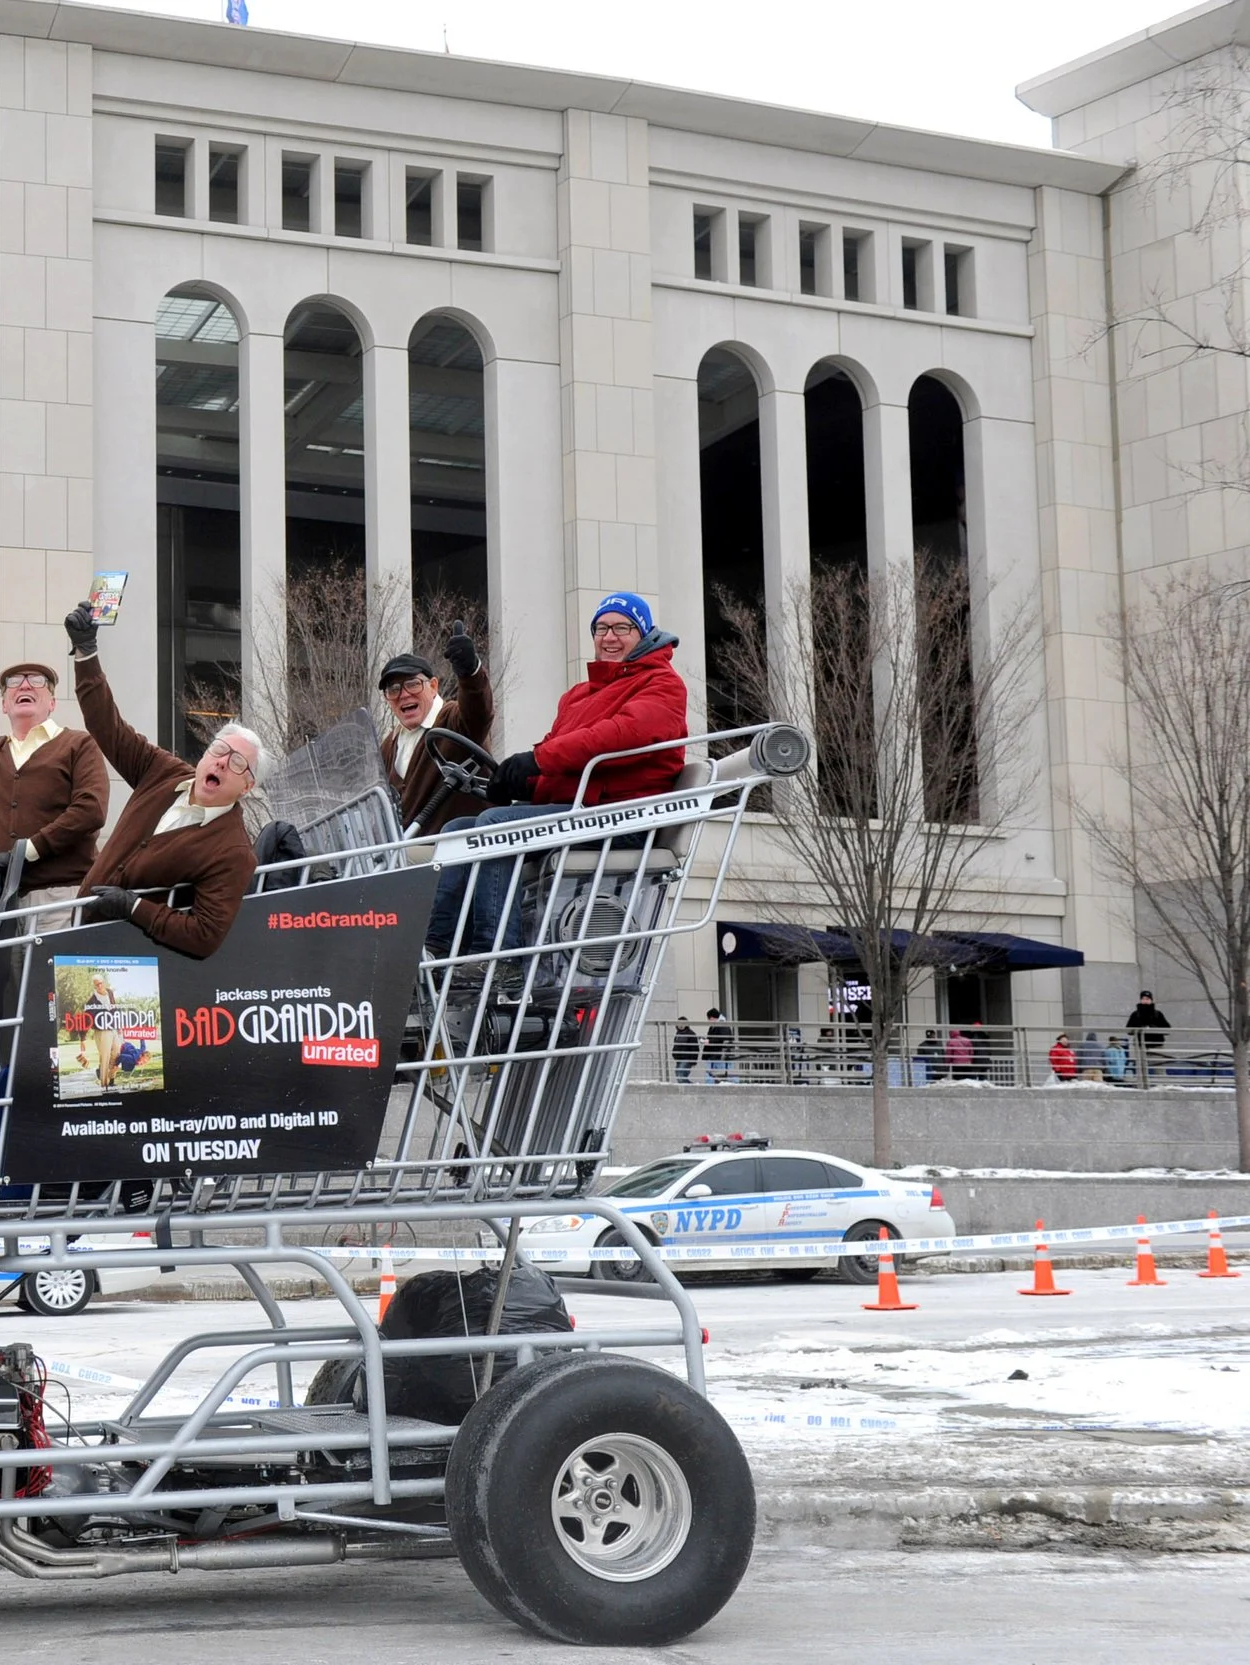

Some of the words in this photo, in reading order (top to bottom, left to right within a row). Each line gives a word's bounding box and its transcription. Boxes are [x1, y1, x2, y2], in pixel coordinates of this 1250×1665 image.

[466, 798, 699, 850] ShopperChopper.com
[268, 910, 398, 930] #BadGrandpa
[215, 988, 268, 1004] jackass
[271, 985, 331, 1002] presents
[65, 1012, 94, 1032] BAD
[94, 1010, 155, 1030] GRANDPA
[175, 1007, 235, 1047] BAD
[238, 1001, 375, 1044] GRANDPA
[124, 1030, 156, 1038] unrated
[303, 1044, 377, 1063] unrated
[61, 1120, 126, 1136] Available
[130, 1122, 147, 1134] on
[151, 1115, 236, 1134] Blu-ray/DVD
[240, 1113, 267, 1129] and
[270, 1111, 315, 1131] Digital
[318, 1111, 338, 1126] HD
[142, 1143, 170, 1163] ON
[175, 1139, 261, 1162] TUESDAY
[674, 1208, 742, 1233] NYPD
